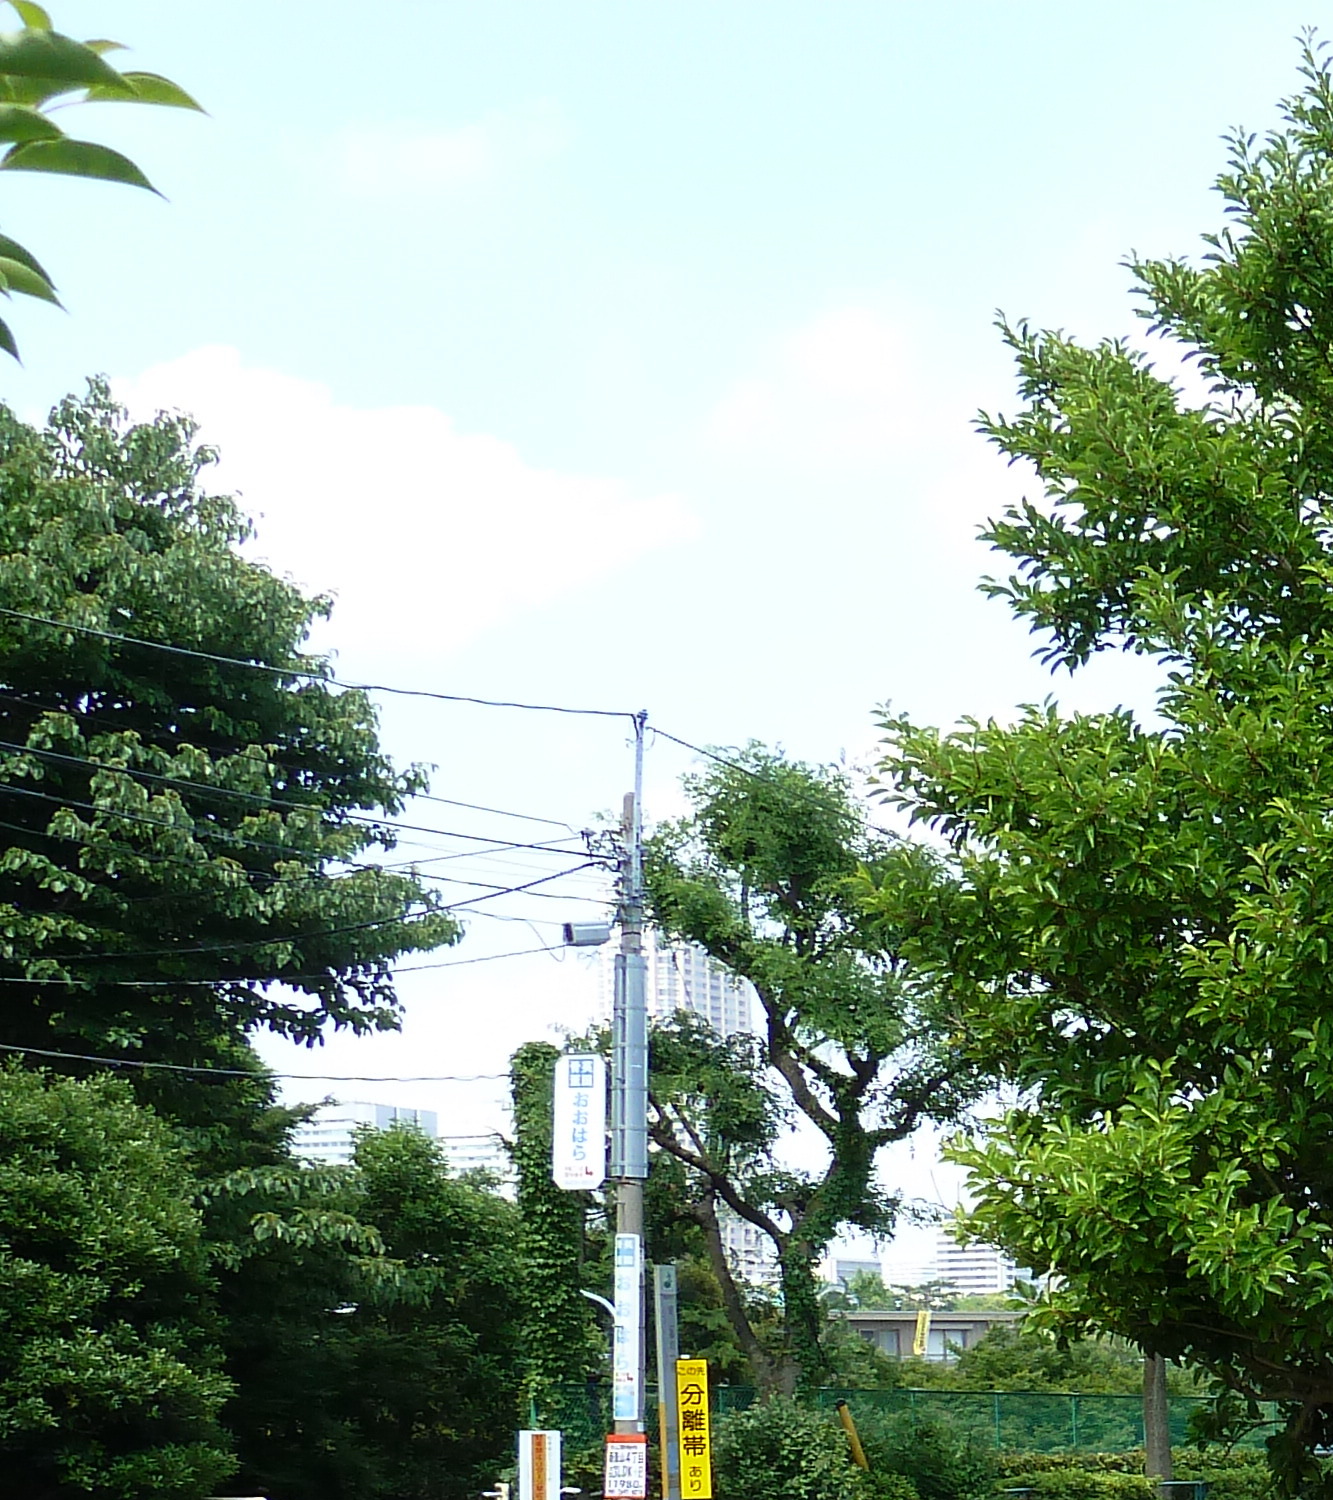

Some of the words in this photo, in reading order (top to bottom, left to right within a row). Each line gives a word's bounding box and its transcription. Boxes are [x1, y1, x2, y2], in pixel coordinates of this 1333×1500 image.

[572, 1092, 589, 1161] おおはら
[677, 1366, 705, 1376] この先
[680, 1383, 706, 1457] 分離帯
[689, 1466, 702, 1492] あり
